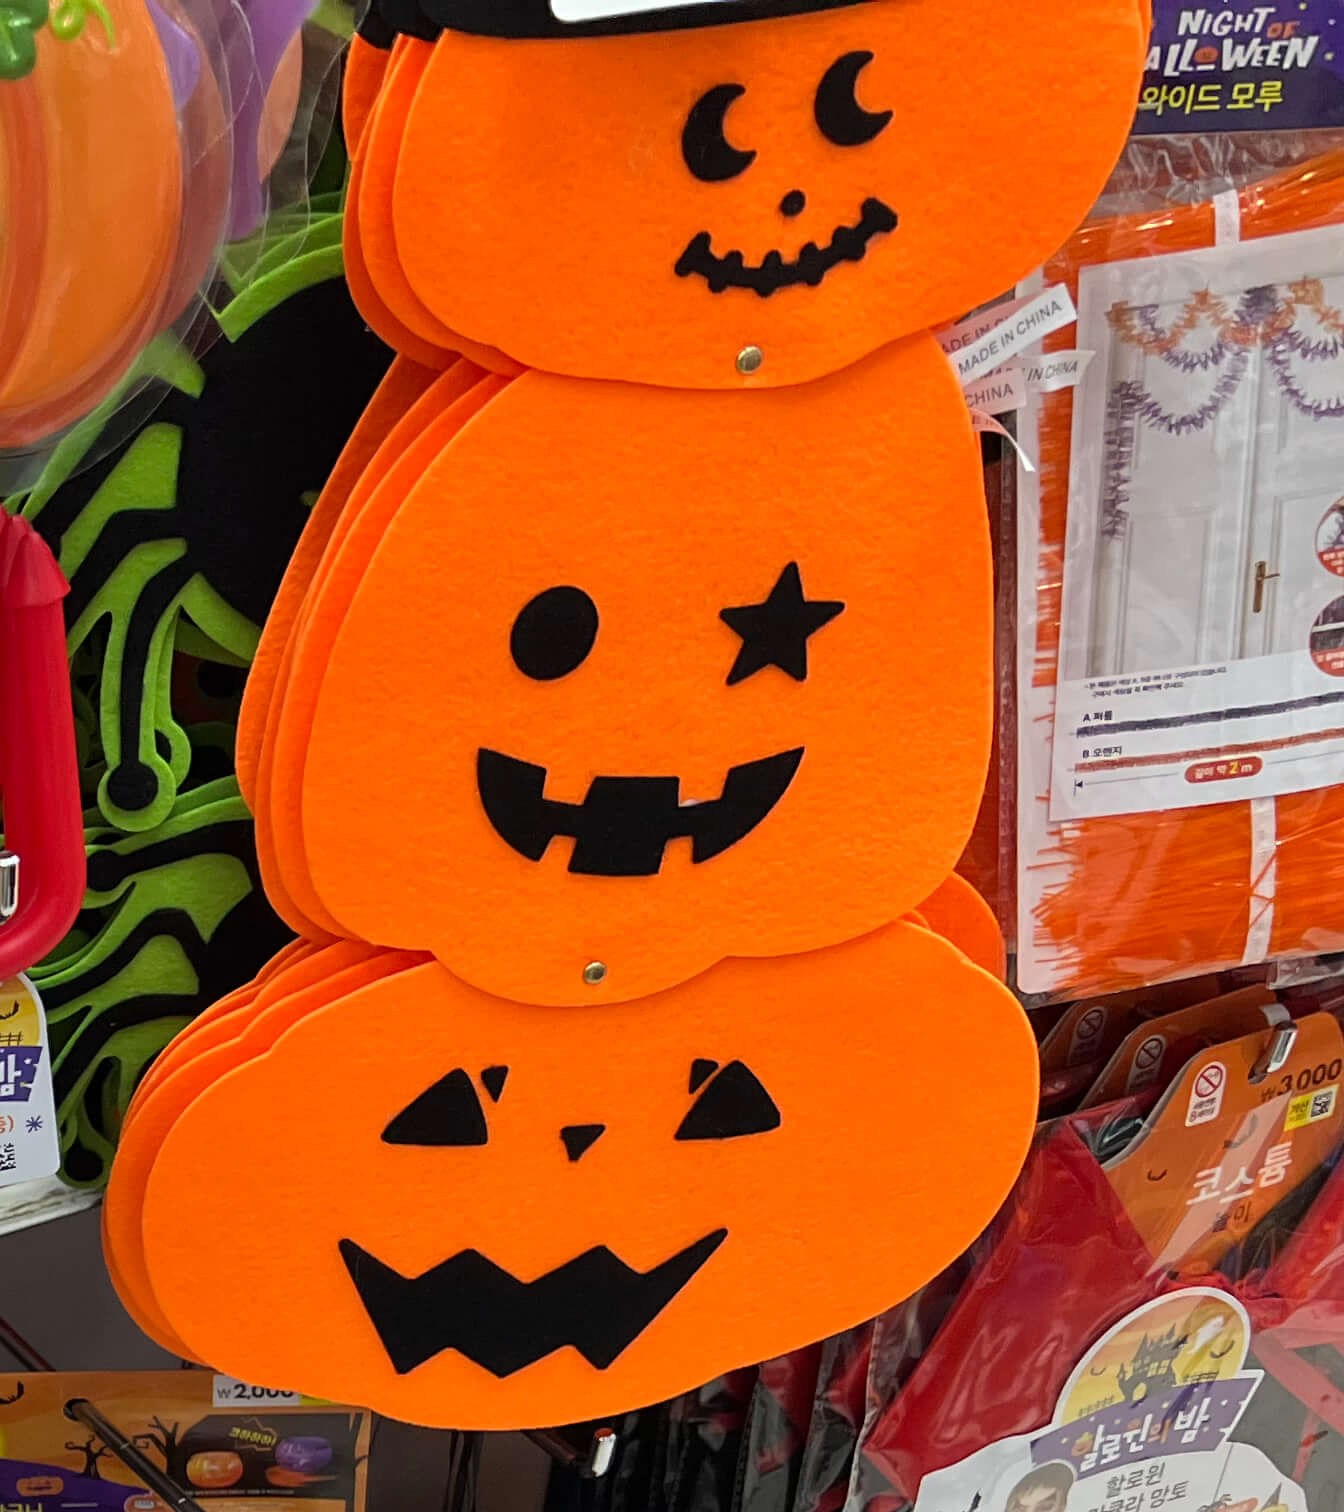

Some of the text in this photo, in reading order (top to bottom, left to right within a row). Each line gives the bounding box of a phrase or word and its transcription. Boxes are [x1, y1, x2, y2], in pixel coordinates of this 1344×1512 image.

[1177, 7, 1301, 39] NIGHT OF
[1144, 35, 1320, 77] ALLOWEEN
[1138, 80, 1284, 116] 와이드 모루
[957, 299, 1063, 376] MADE IN CHINA
[1186, 1141, 1293, 1206] 코스튬
[1174, 1397, 1211, 1445] 밤
[1105, 1461, 1166, 1500] 할로윈
[1149, 1480, 1190, 1509] 망토
